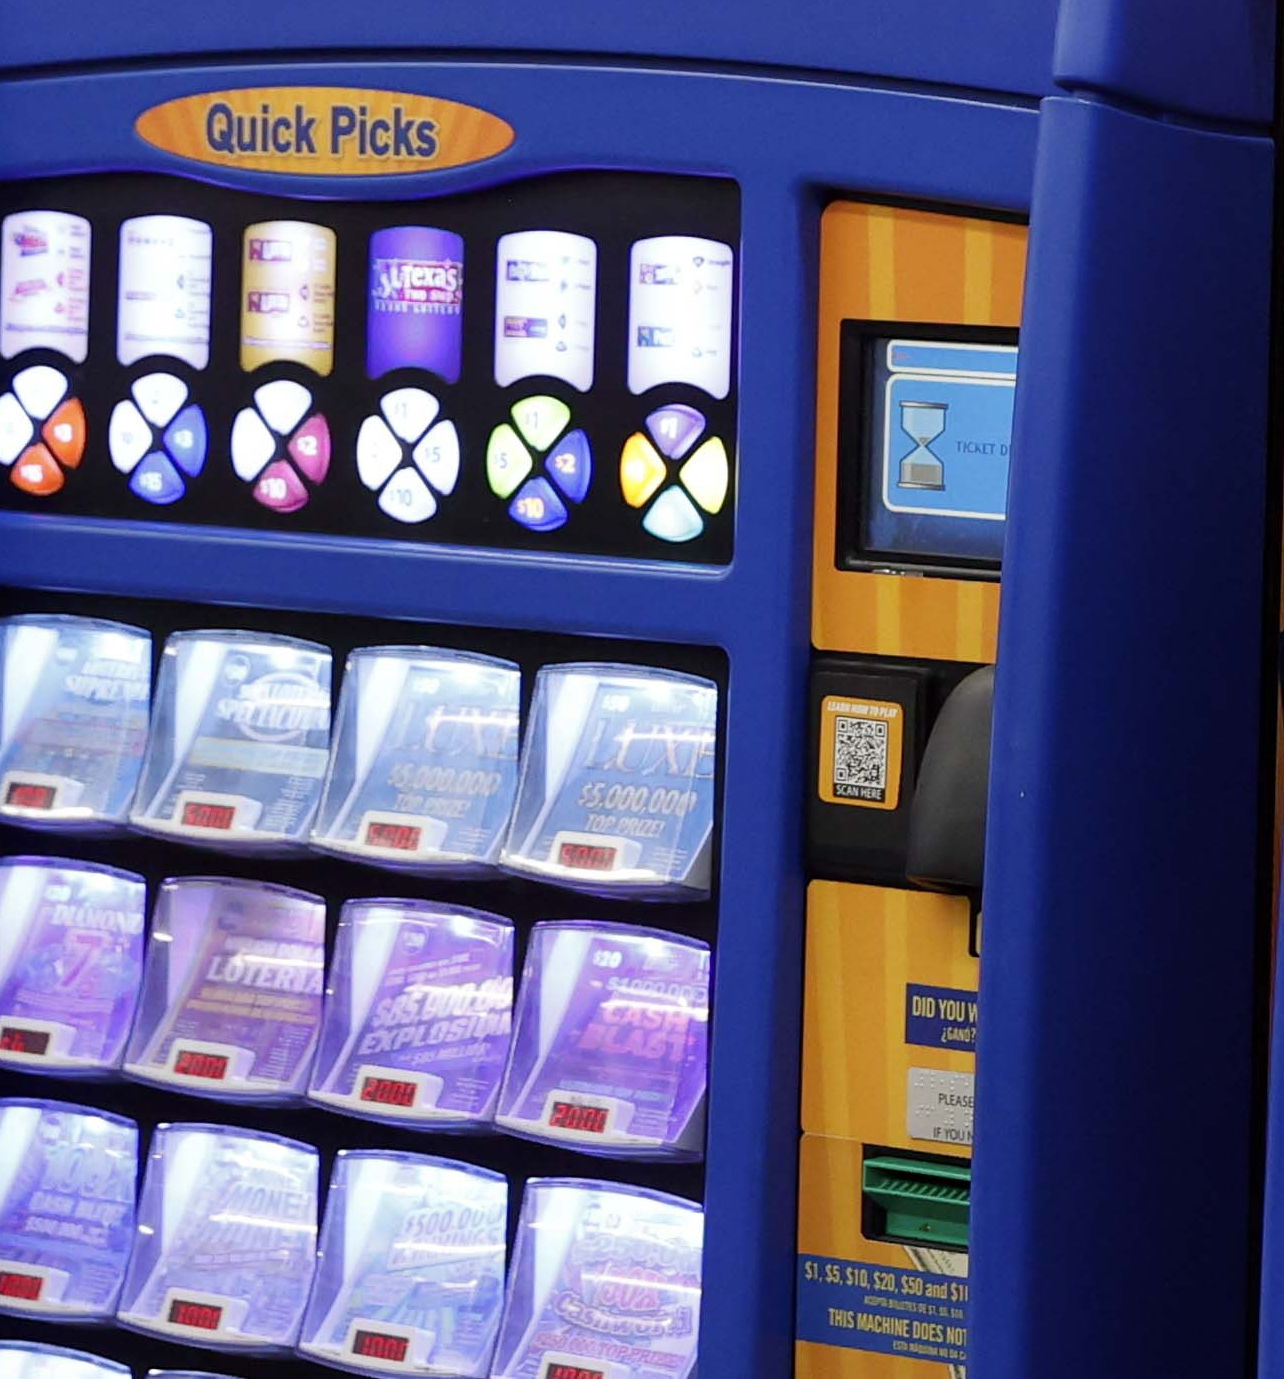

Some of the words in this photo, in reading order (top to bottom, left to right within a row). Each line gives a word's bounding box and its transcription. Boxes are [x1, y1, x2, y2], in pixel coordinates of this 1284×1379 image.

[205, 103, 316, 157] Quick
[329, 106, 437, 159] Picks
[956, 439, 997, 456] TICKET
[554, 453, 577, 473] $2
[517, 497, 546, 520] $10
[584, 718, 715, 781] LUXE
[835, 785, 859, 797] SCAN
[860, 788, 883, 800] HERE
[585, 814, 615, 832] TOP
[206, 955, 325, 995] LOTERIA
[912, 995, 935, 1018] DID
[938, 999, 965, 1023] YOU
[938, 1093, 975, 1108] PLEASE
[933, 1127, 942, 1139] IF
[944, 1128, 965, 1141] YOU
[805, 1261, 823, 1282] $1,
[825, 1264, 844, 1285] $5,
[846, 1266, 871, 1290] $10,
[873, 1270, 898, 1294] $20,
[901, 1275, 923, 1297] $50
[925, 1280, 948, 1300] and
[828, 1308, 854, 1329] THIS
[857, 1312, 910, 1338] MACHINE
[912, 1321, 944, 1343] DOES
